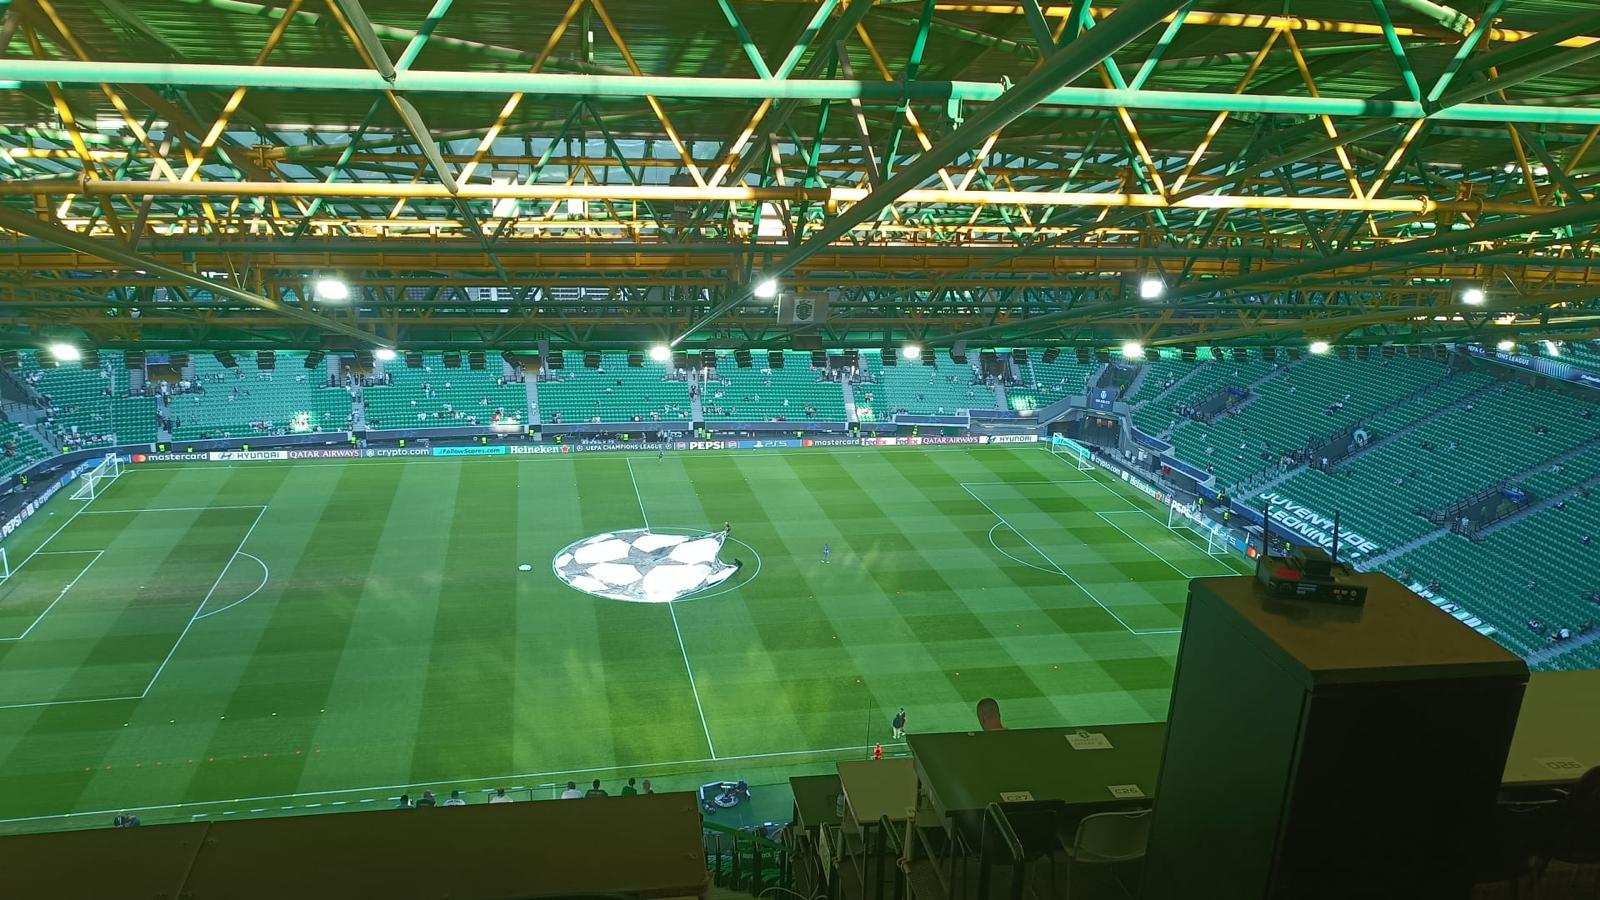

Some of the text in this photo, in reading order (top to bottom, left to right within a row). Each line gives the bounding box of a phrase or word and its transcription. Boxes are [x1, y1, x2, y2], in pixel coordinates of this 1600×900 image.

[1508, 354, 1530, 366] LEAGUE
[510, 446, 559, 454] Heineken
[689, 441, 725, 450] PEPSI
[148, 453, 208, 461] mastercard
[236, 451, 281, 459] HYUNDAI
[289, 449, 360, 459] QATAR AIRWAYS
[377, 448, 430, 457] crypto.com
[1095, 456, 1121, 476] crypto.com
[1129, 474, 1156, 497] Heineken
[2, 513, 22, 537] PEPSI
